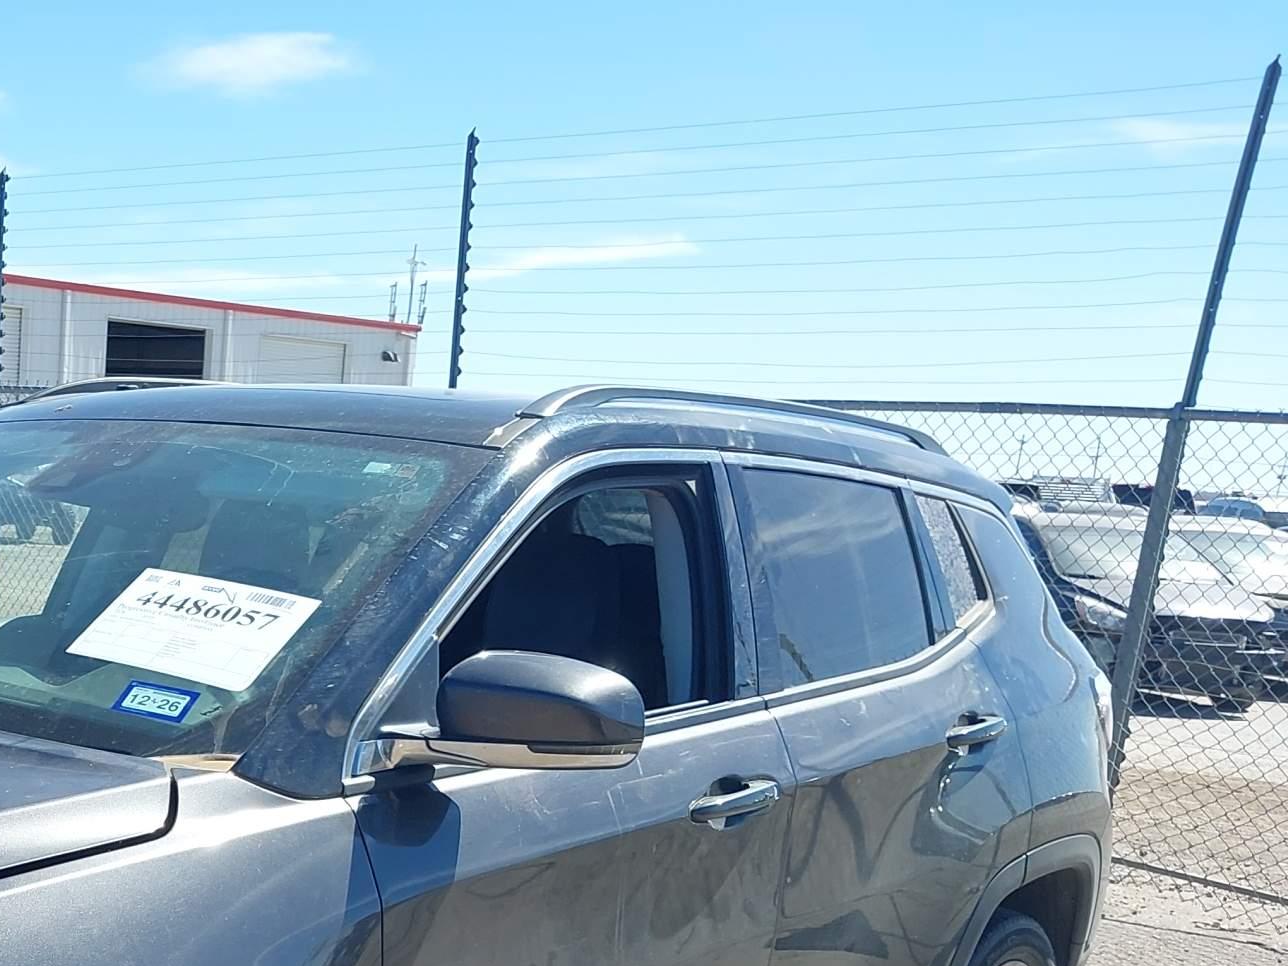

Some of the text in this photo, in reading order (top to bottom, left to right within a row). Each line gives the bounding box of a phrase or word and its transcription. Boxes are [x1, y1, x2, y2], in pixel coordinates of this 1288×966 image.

[136, 590, 281, 630] 44486057
[129, 693, 151, 706] 12
[156, 698, 182, 712] 26
